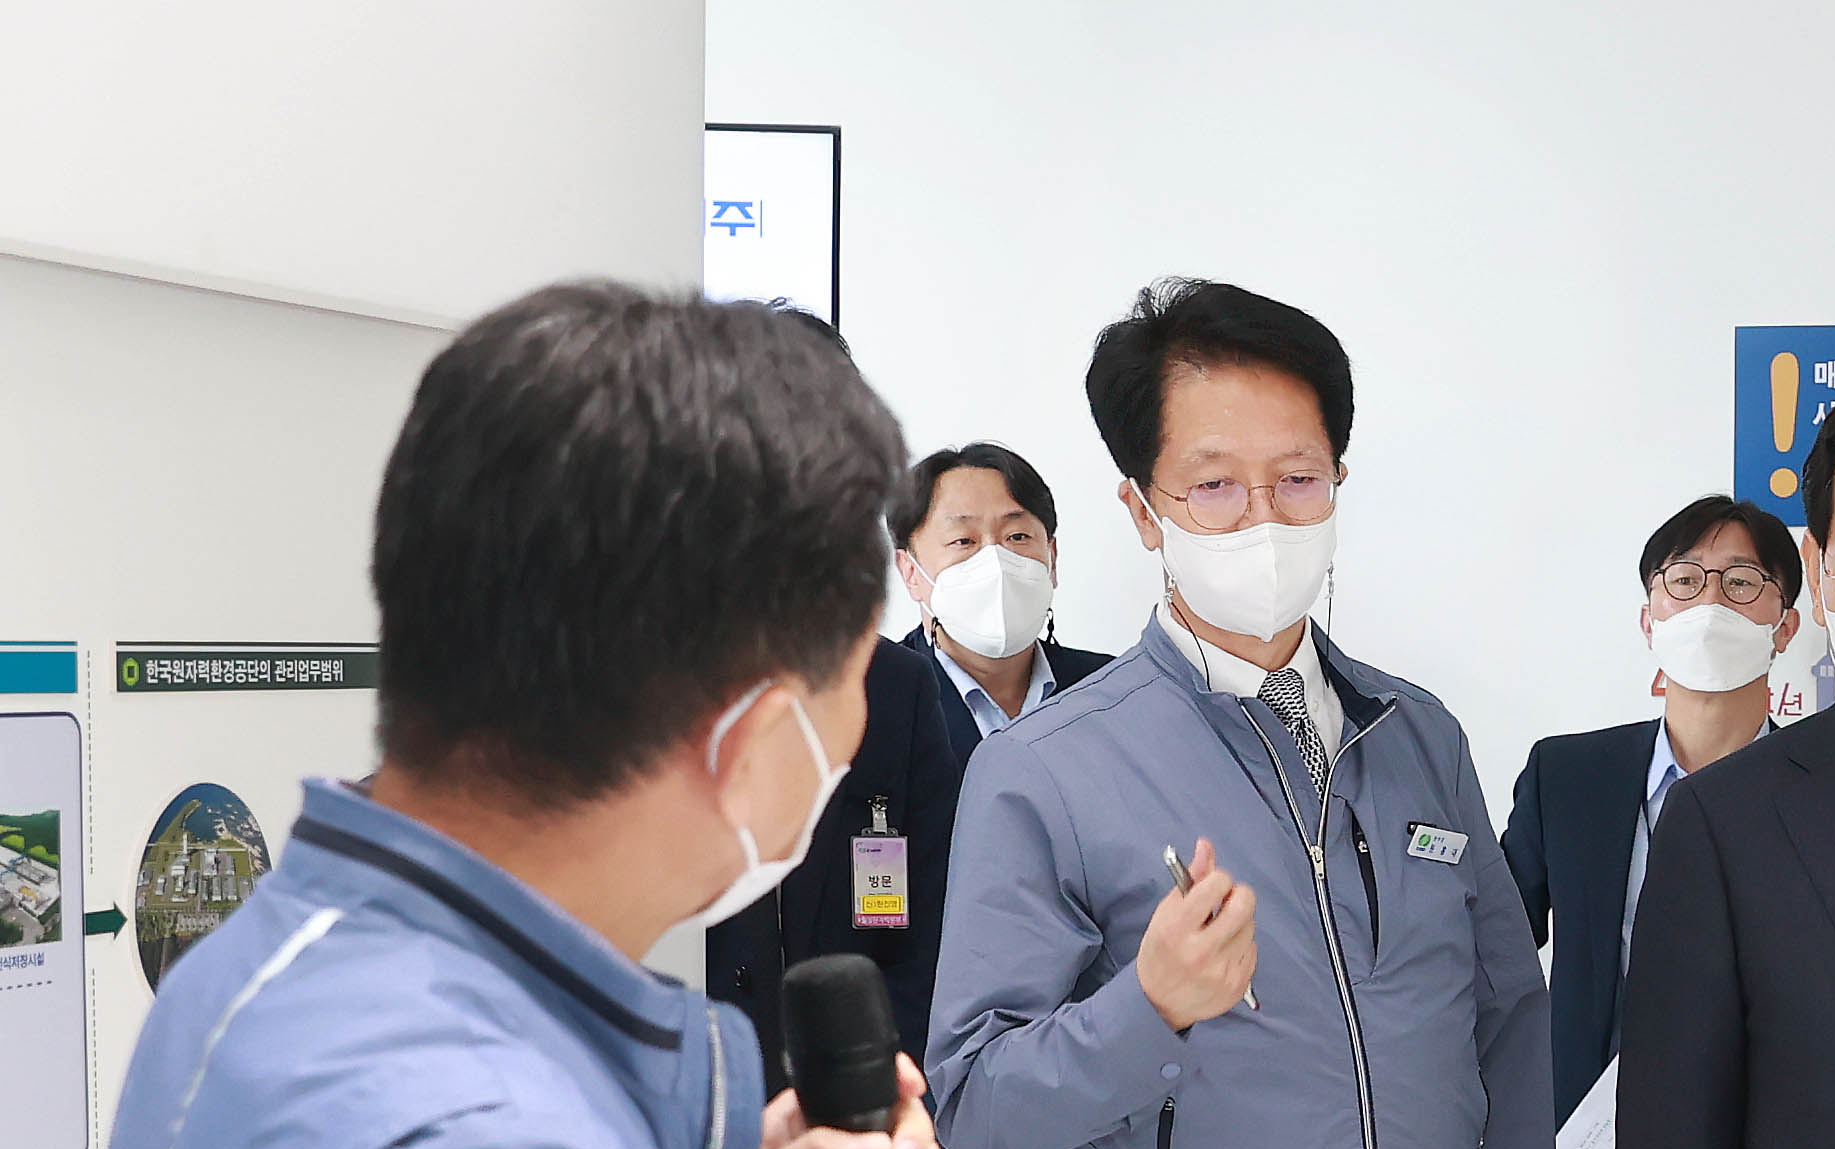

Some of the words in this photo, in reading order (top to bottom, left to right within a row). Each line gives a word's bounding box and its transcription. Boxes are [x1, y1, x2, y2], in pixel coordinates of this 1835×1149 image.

[710, 200, 755, 236] 주
[146, 659, 272, 684] 한국원자력환경공단의
[274, 659, 344, 683] 관리업무범위
